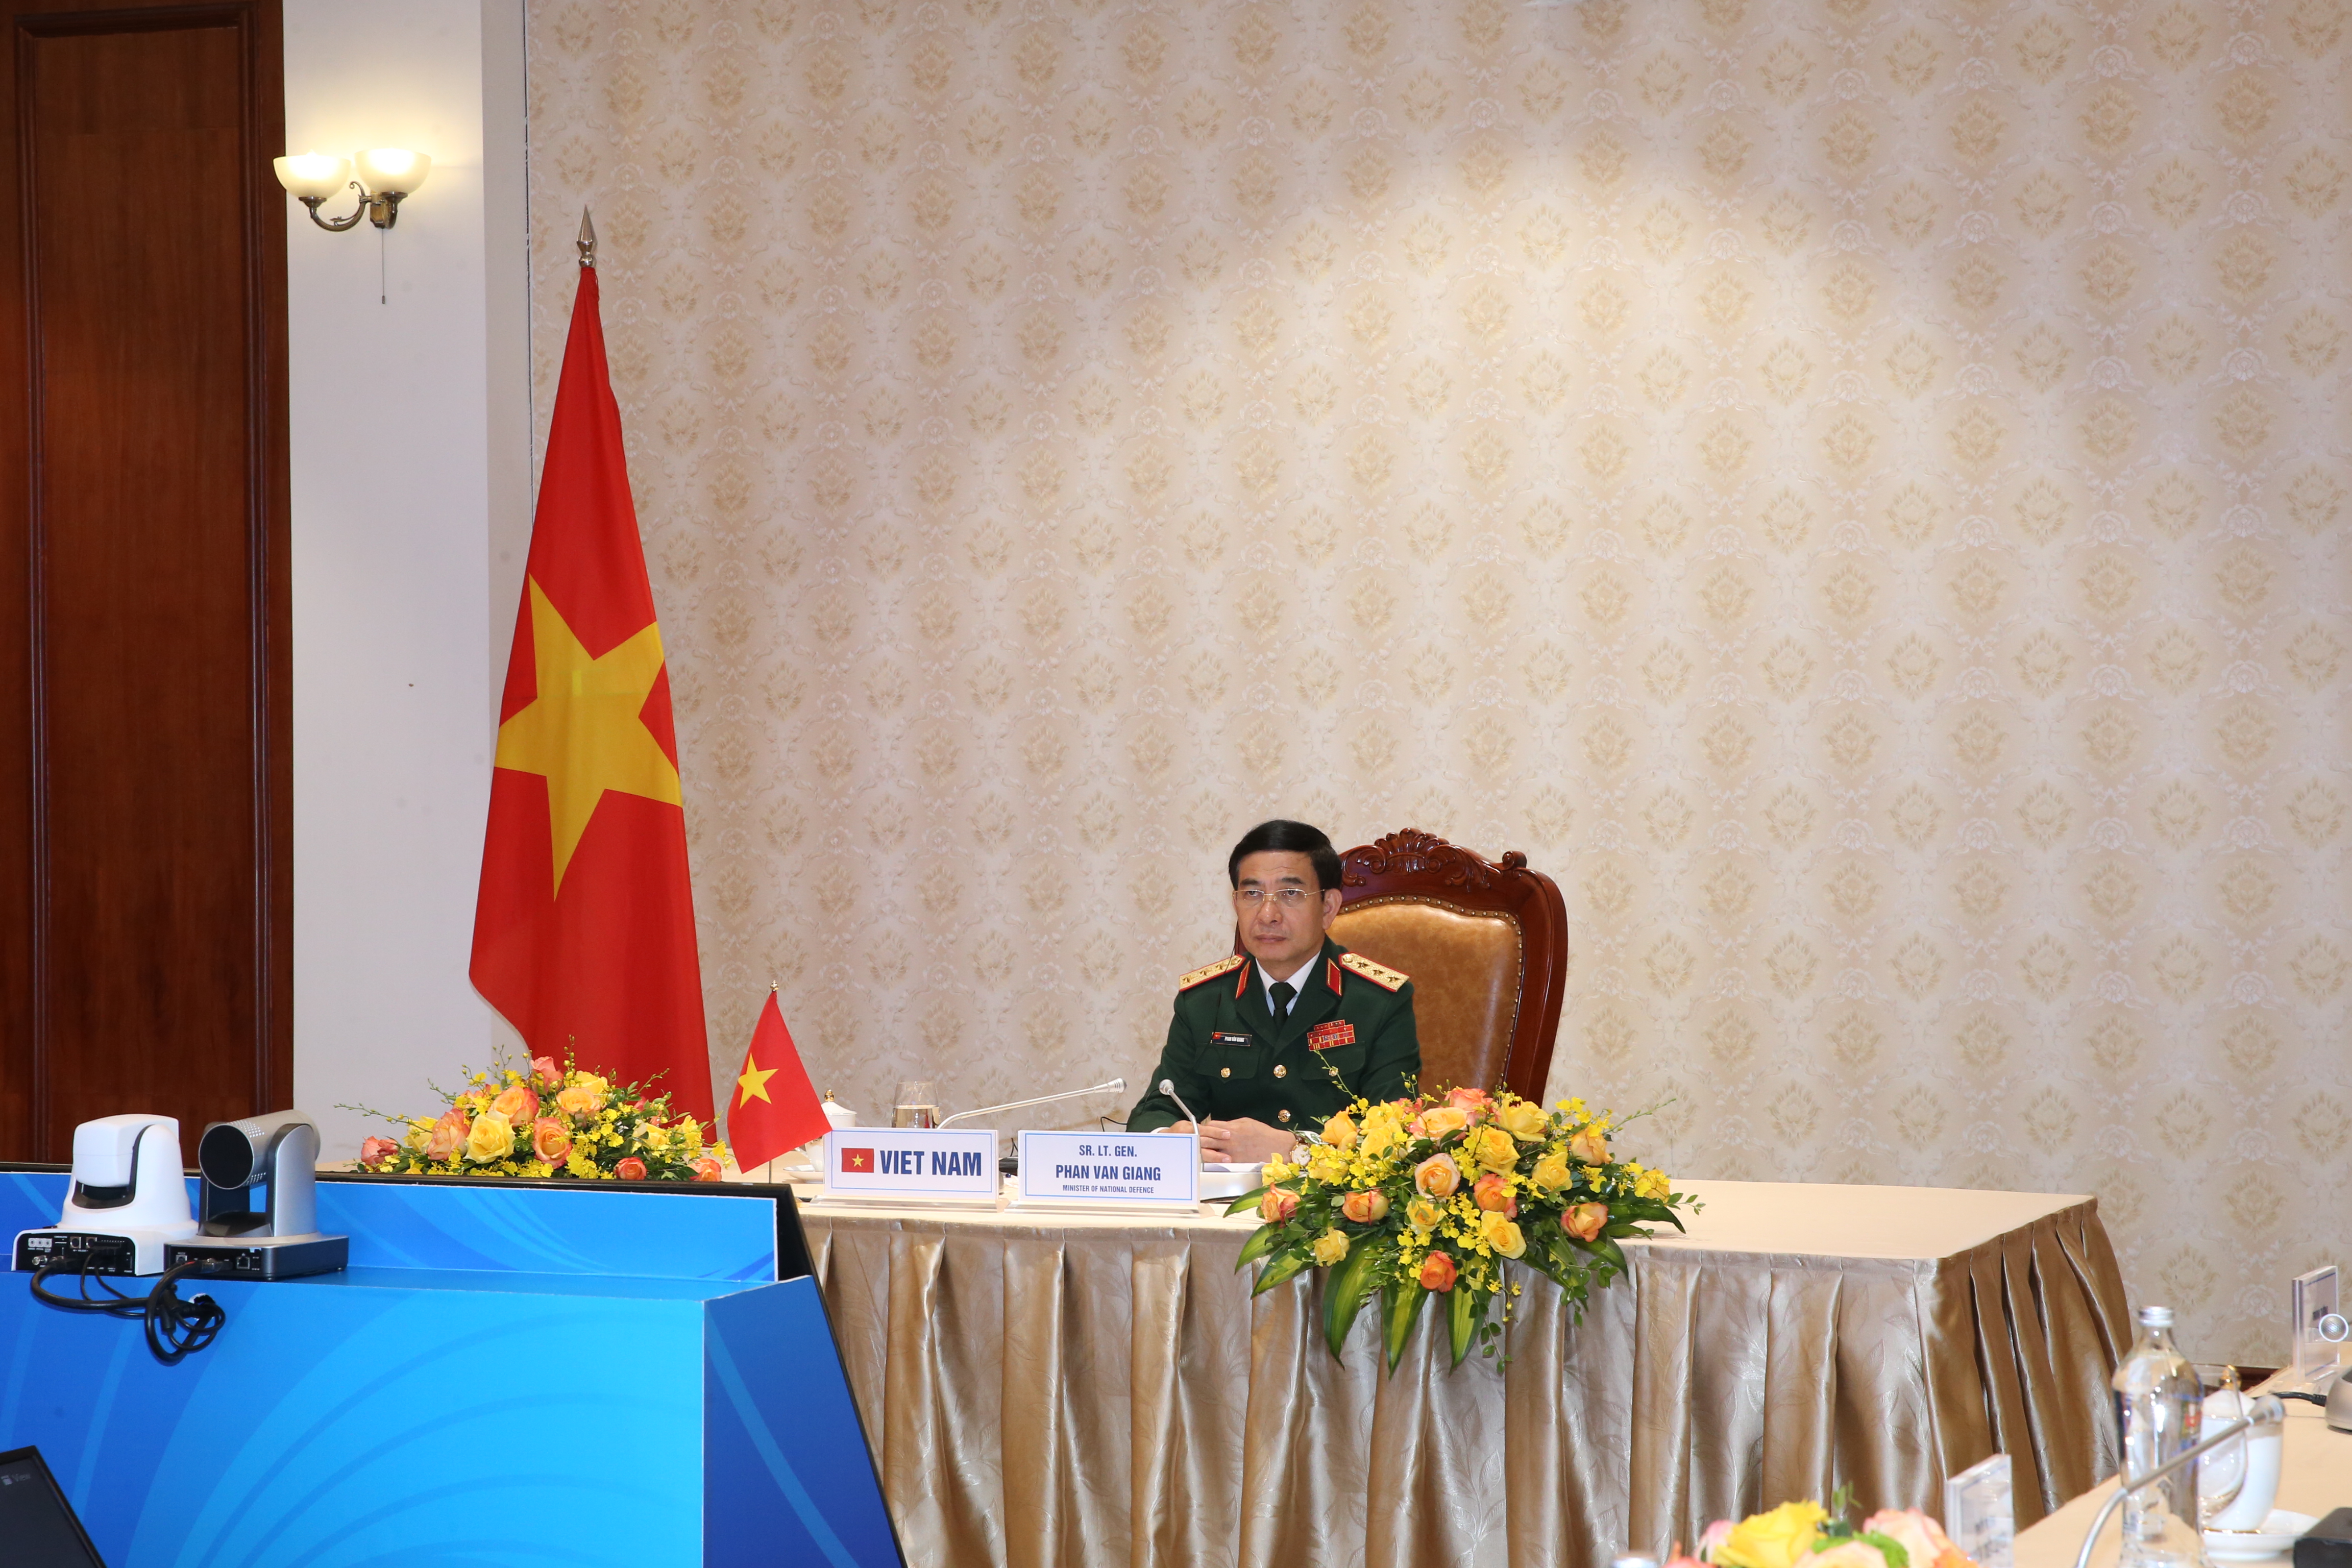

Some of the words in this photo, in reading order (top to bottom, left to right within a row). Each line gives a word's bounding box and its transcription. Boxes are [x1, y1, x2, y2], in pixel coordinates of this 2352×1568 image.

[1079, 1144, 1095, 1156] SR.
[1098, 1145, 1112, 1157] LT.
[1114, 1145, 1137, 1157] GEN.
[879, 1150, 925, 1175] VIET
[932, 1151, 982, 1177] NAM
[1056, 1164, 1089, 1179] PHAN
[1093, 1165, 1118, 1180] VAN
[1122, 1166, 1161, 1181] GIANG
